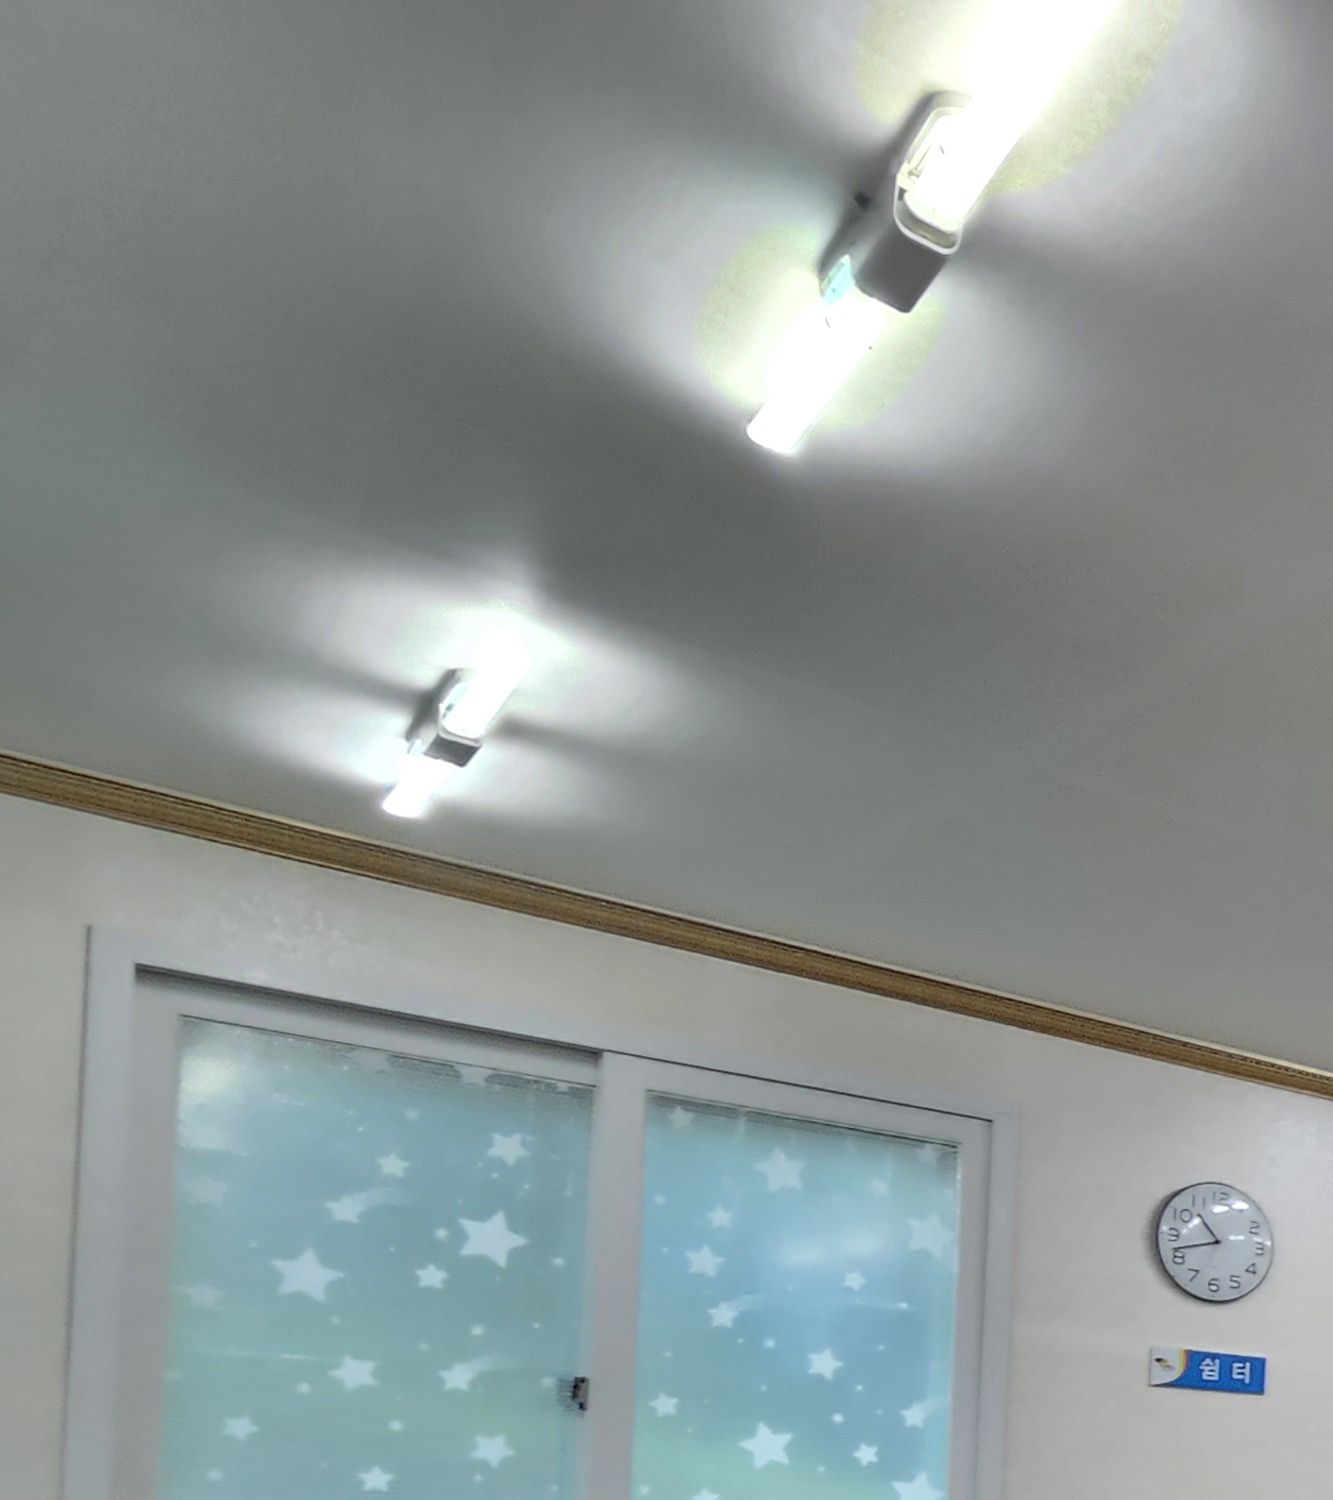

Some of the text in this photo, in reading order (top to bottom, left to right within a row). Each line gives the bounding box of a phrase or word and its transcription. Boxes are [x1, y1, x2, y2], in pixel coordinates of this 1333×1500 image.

[1191, 1194, 1206, 1209] 11
[1173, 1207, 1193, 1224] 10
[1167, 1226, 1180, 1242] 9
[1248, 1220, 1260, 1235] 2
[1172, 1249, 1185, 1265] 8
[1187, 1268, 1200, 1282] 7
[1244, 1262, 1257, 1275] 4
[1207, 1277, 1220, 1293] 6
[1229, 1274, 1241, 1290] 5
